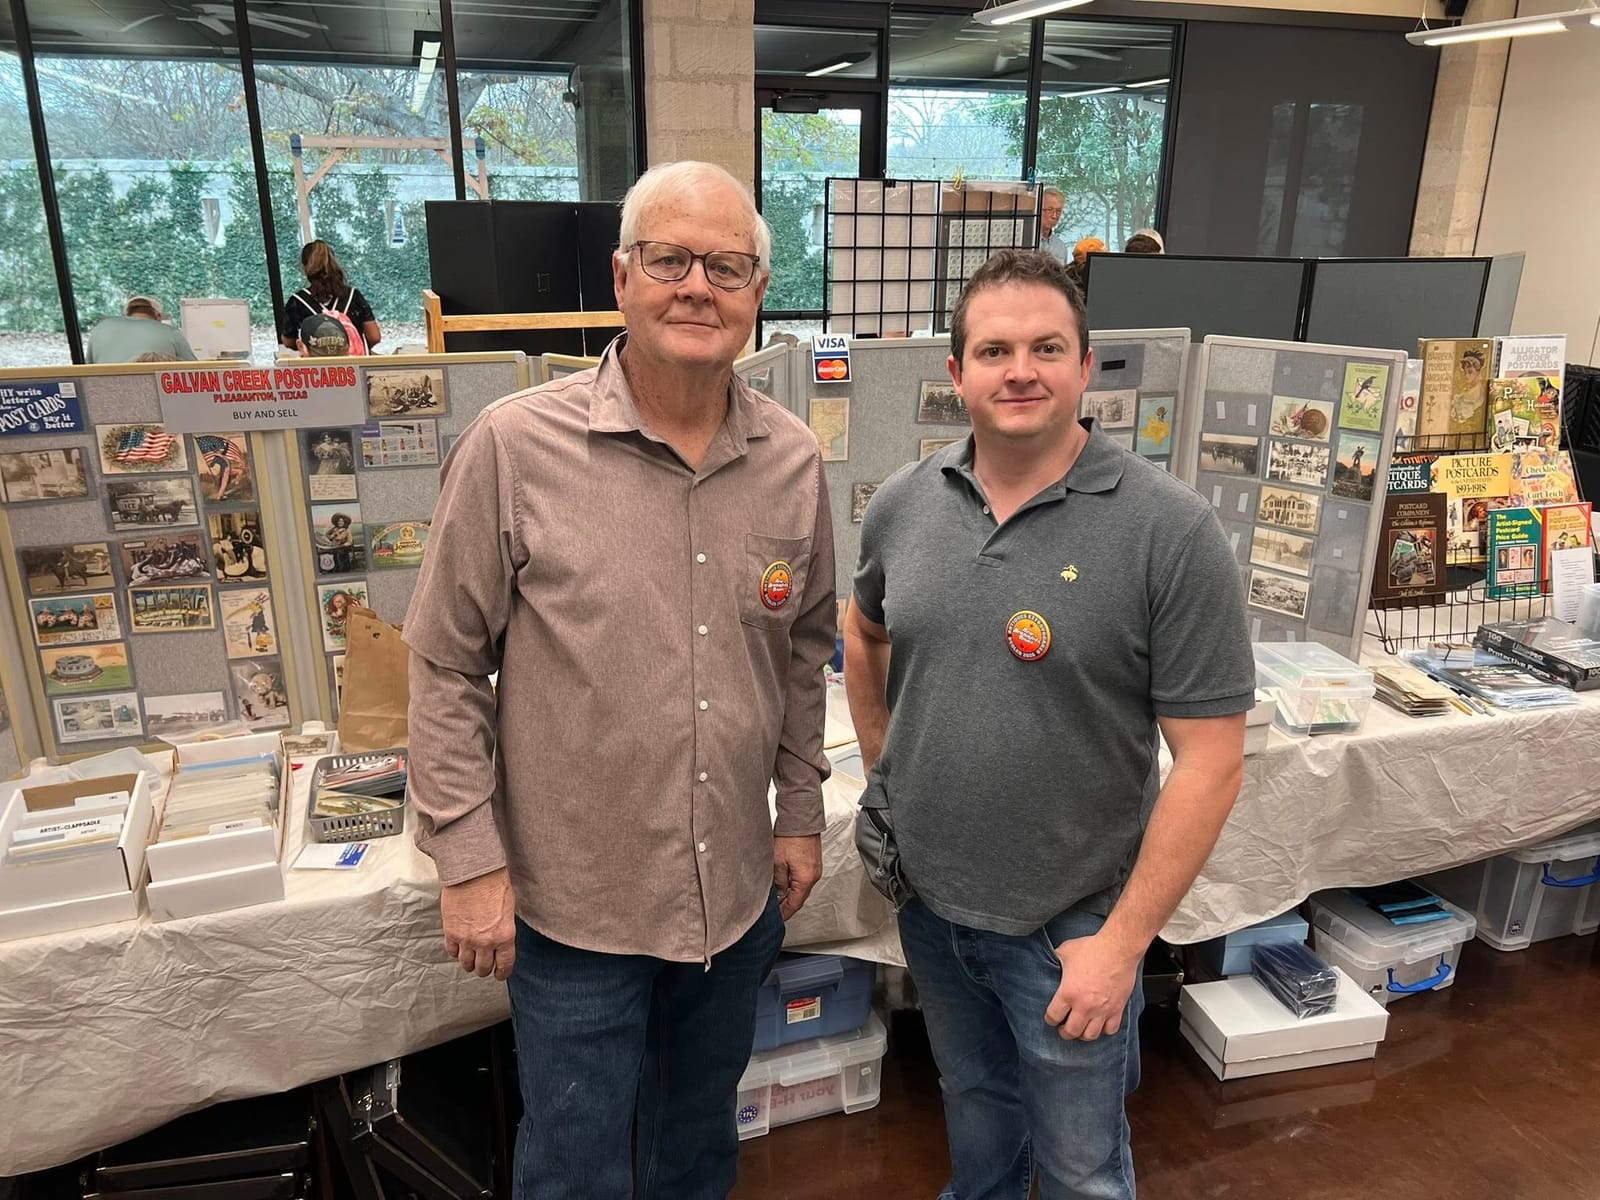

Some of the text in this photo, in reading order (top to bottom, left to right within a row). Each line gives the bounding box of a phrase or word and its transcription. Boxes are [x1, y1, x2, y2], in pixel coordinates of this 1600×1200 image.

[818, 338, 846, 349] VISA
[1510, 346, 1559, 355] ALLIGATOR
[1516, 353, 1551, 361] BORDER
[1507, 360, 1559, 370] POSTCARDS
[160, 366, 357, 394] GALVAN CREEK POSTCARDS
[0, 388, 43, 398] HY write
[213, 389, 308, 404] PLEASANTON, TEXAS
[2, 396, 31, 406] letter
[0, 393, 67, 432] POST CARDS
[232, 409, 299, 420] BUY AND SELL
[44, 421, 76, 430] better
[1451, 456, 1494, 468] PICTURE
[1445, 466, 1500, 479] POSTCARDS
[1525, 464, 1557, 475] Checklist
[1388, 470, 1422, 482] TIQUE
[1386, 479, 1429, 491] TCARDS
[1456, 483, 1488, 494] 1893-1918
[1487, 631, 1503, 642] 100
[1487, 647, 1526, 669] Protective
[1527, 663, 1551, 679] Pages
